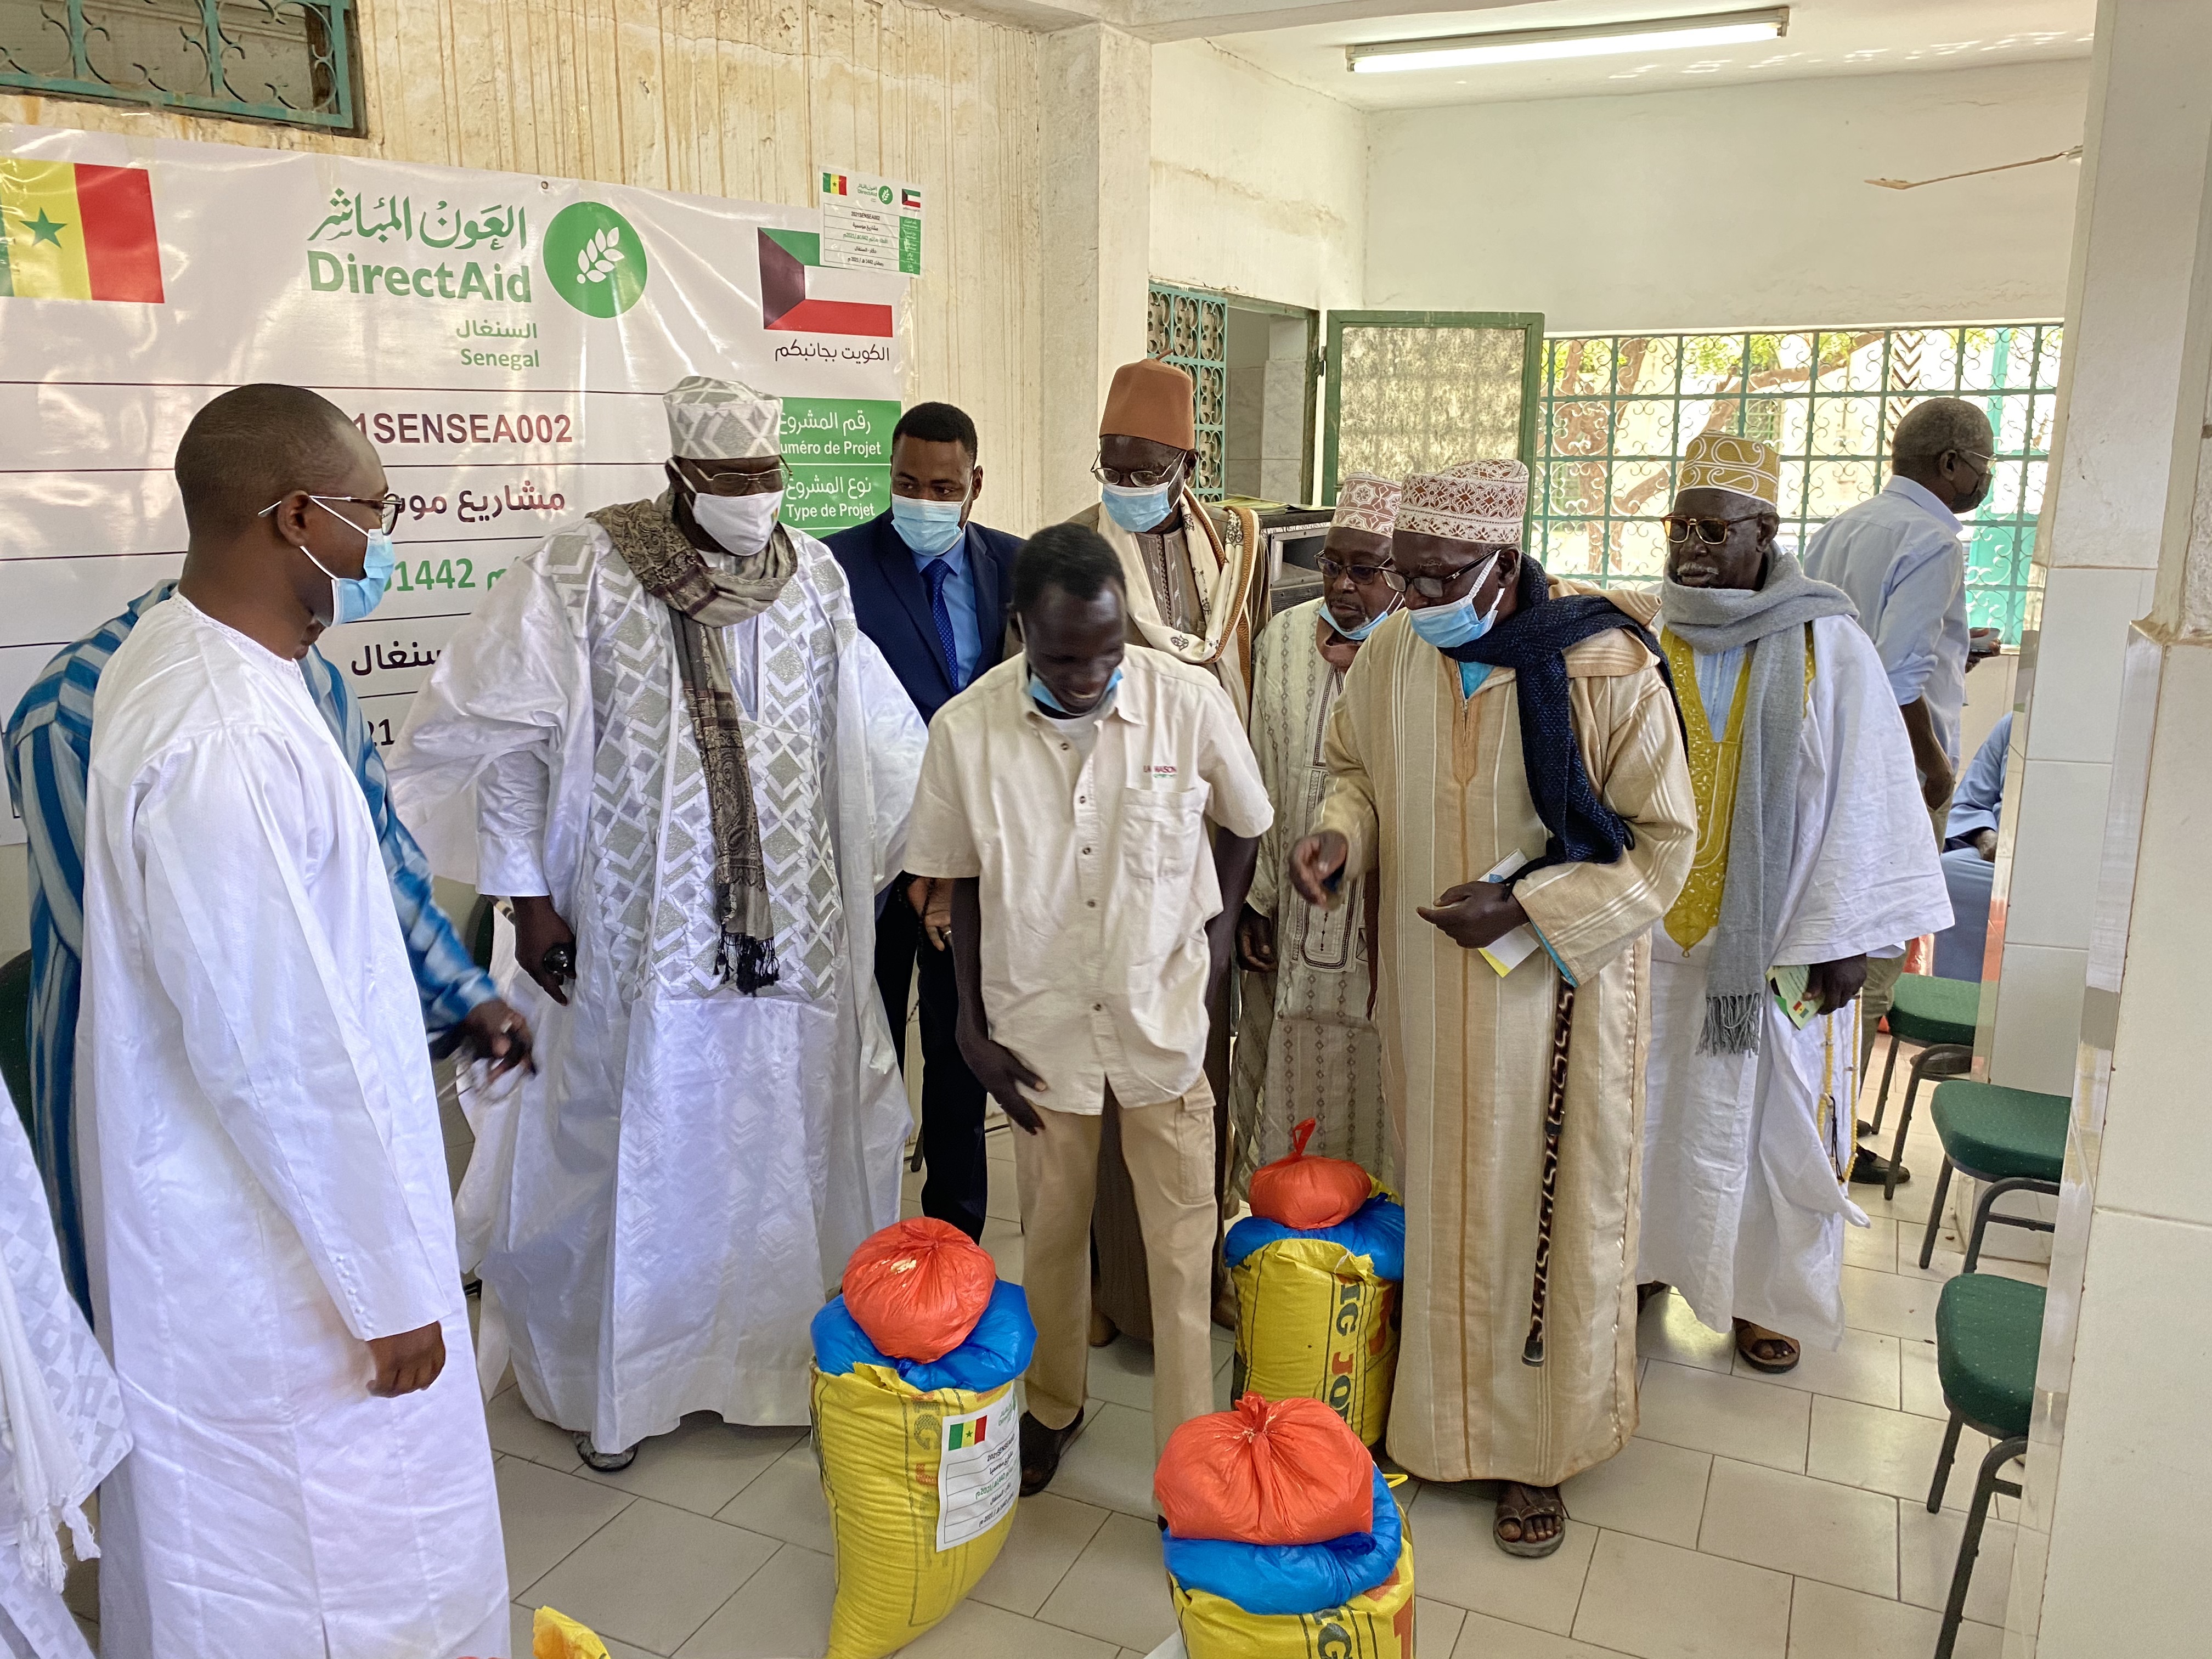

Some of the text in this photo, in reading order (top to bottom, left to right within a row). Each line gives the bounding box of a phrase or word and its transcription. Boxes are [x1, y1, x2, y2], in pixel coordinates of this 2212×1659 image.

[307, 250, 532, 303] DirectAid
[456, 319, 538, 340] السنغال
[460, 348, 540, 371] Senegal
[775, 339, 889, 364] الكويت بجانبكم
[354, 413, 572, 444] 1SENSEA002
[843, 410, 871, 436] رقم
[780, 441, 882, 458] uméro de Projet
[786, 475, 871, 500] نوع المشروع
[458, 480, 565, 523] مشاريع
[786, 503, 876, 521] Type de Projet
[1335, 1274, 1362, 1337] IG
